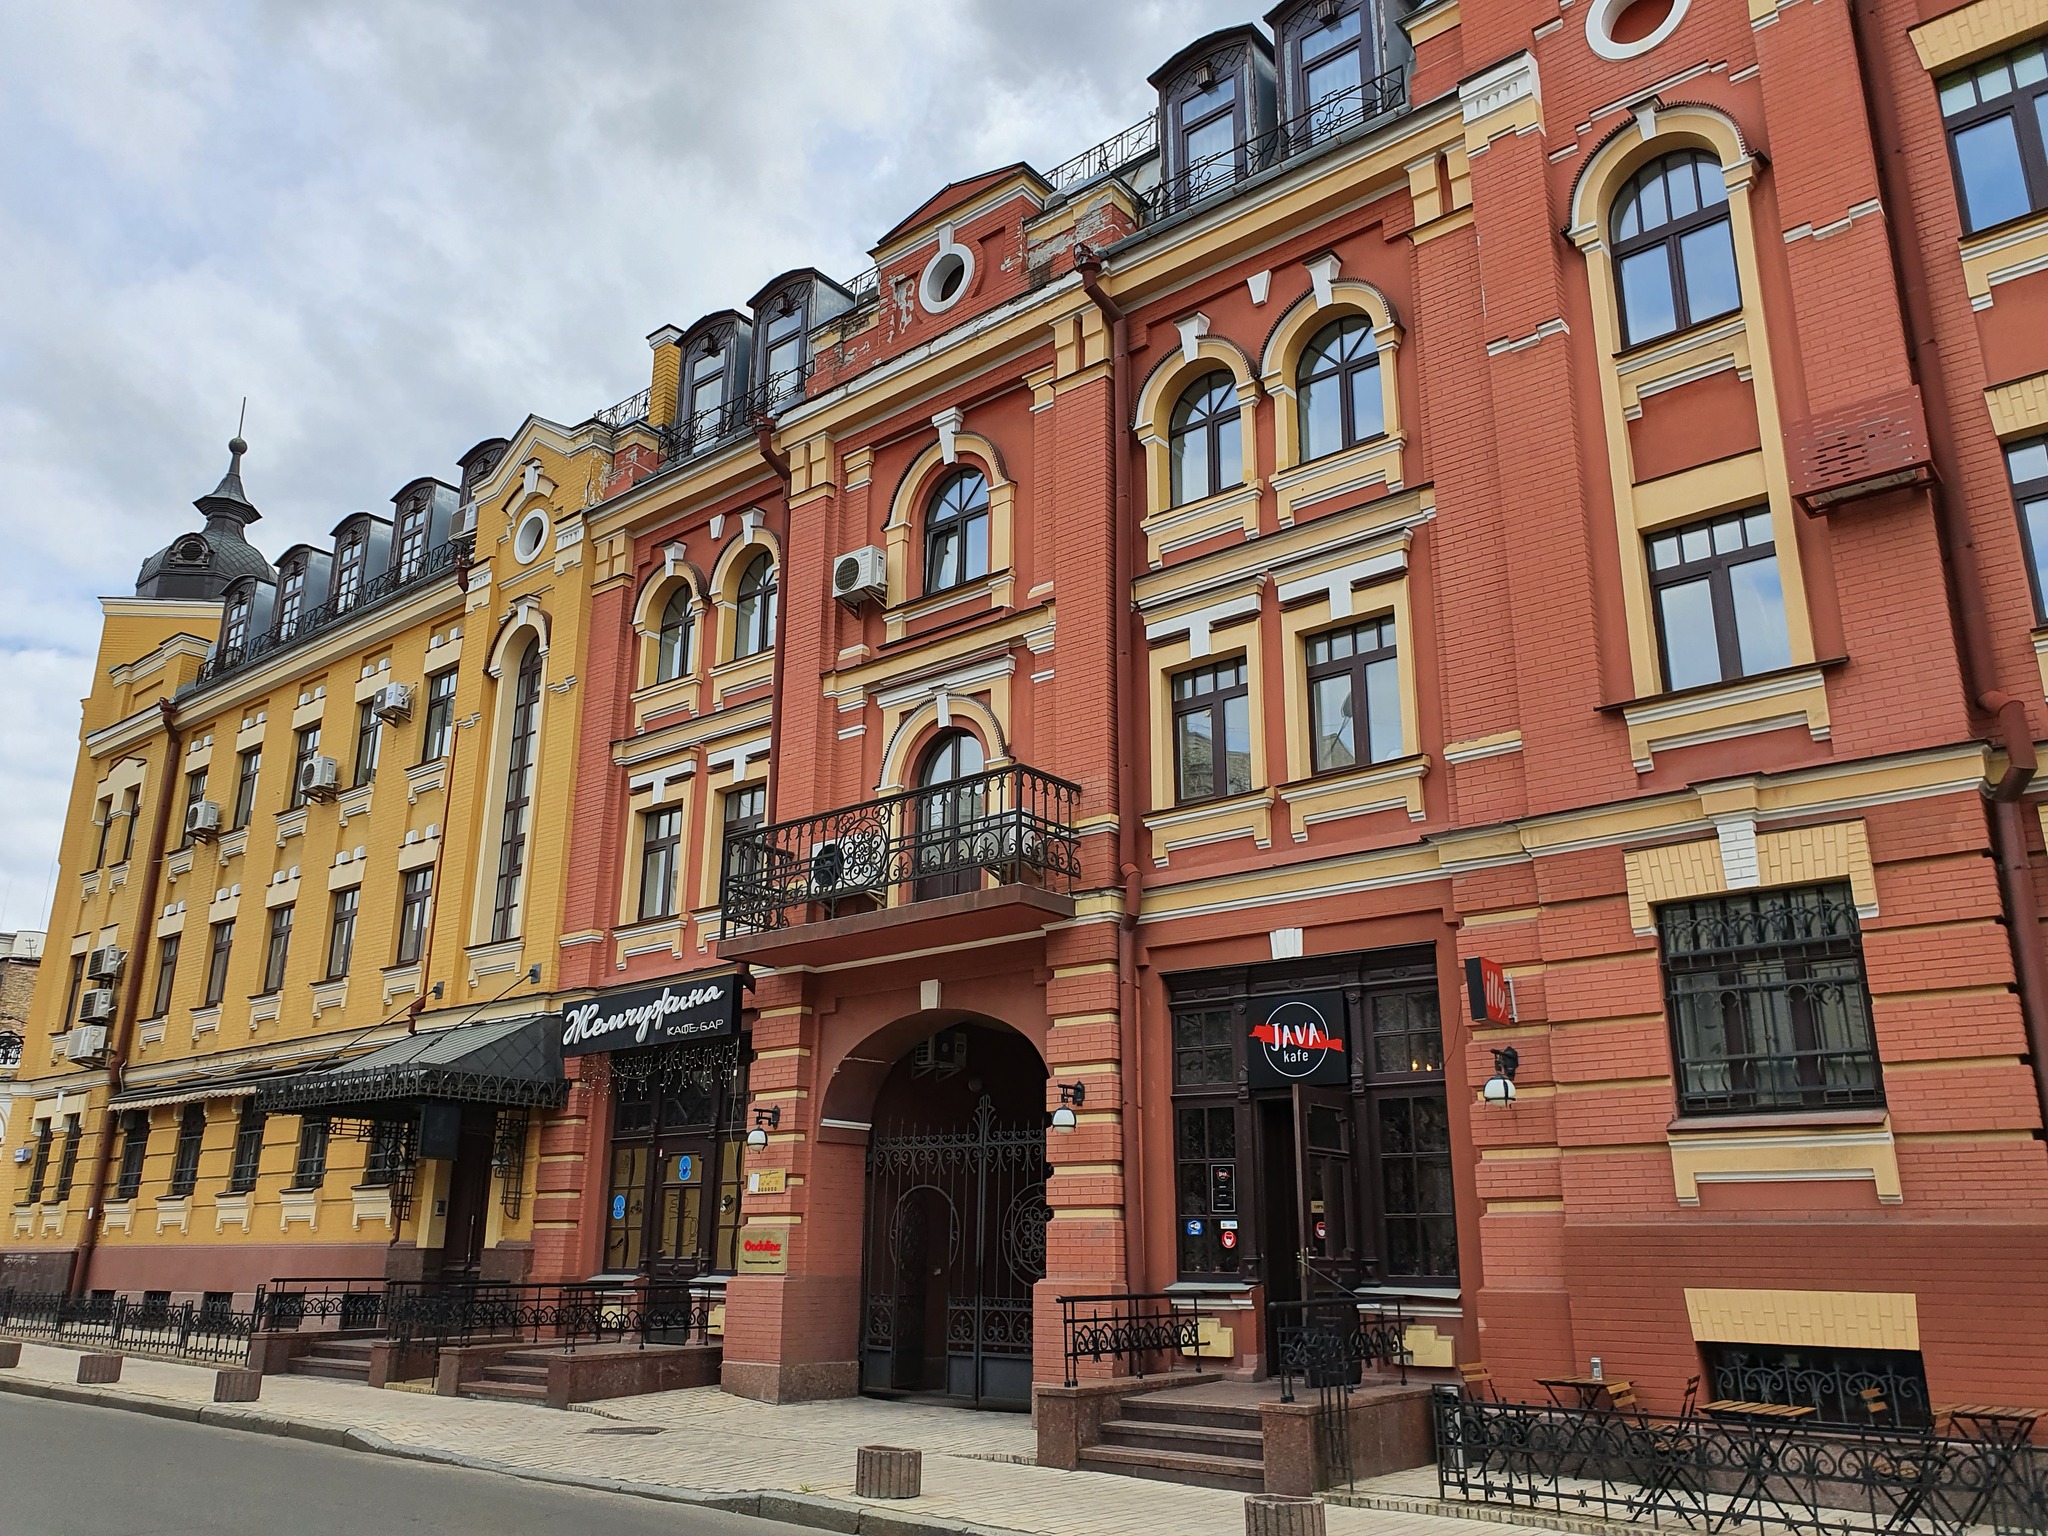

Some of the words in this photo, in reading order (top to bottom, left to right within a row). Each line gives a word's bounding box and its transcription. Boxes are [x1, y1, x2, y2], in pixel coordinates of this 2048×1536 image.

[1486, 970, 1506, 1018] illy
[562, 985, 725, 1045] Жемчужина
[667, 1018, 724, 1036] КАФЕ-БАР
[1270, 1022, 1321, 1052] JAVA
[1283, 1049, 1309, 1063] kafe
